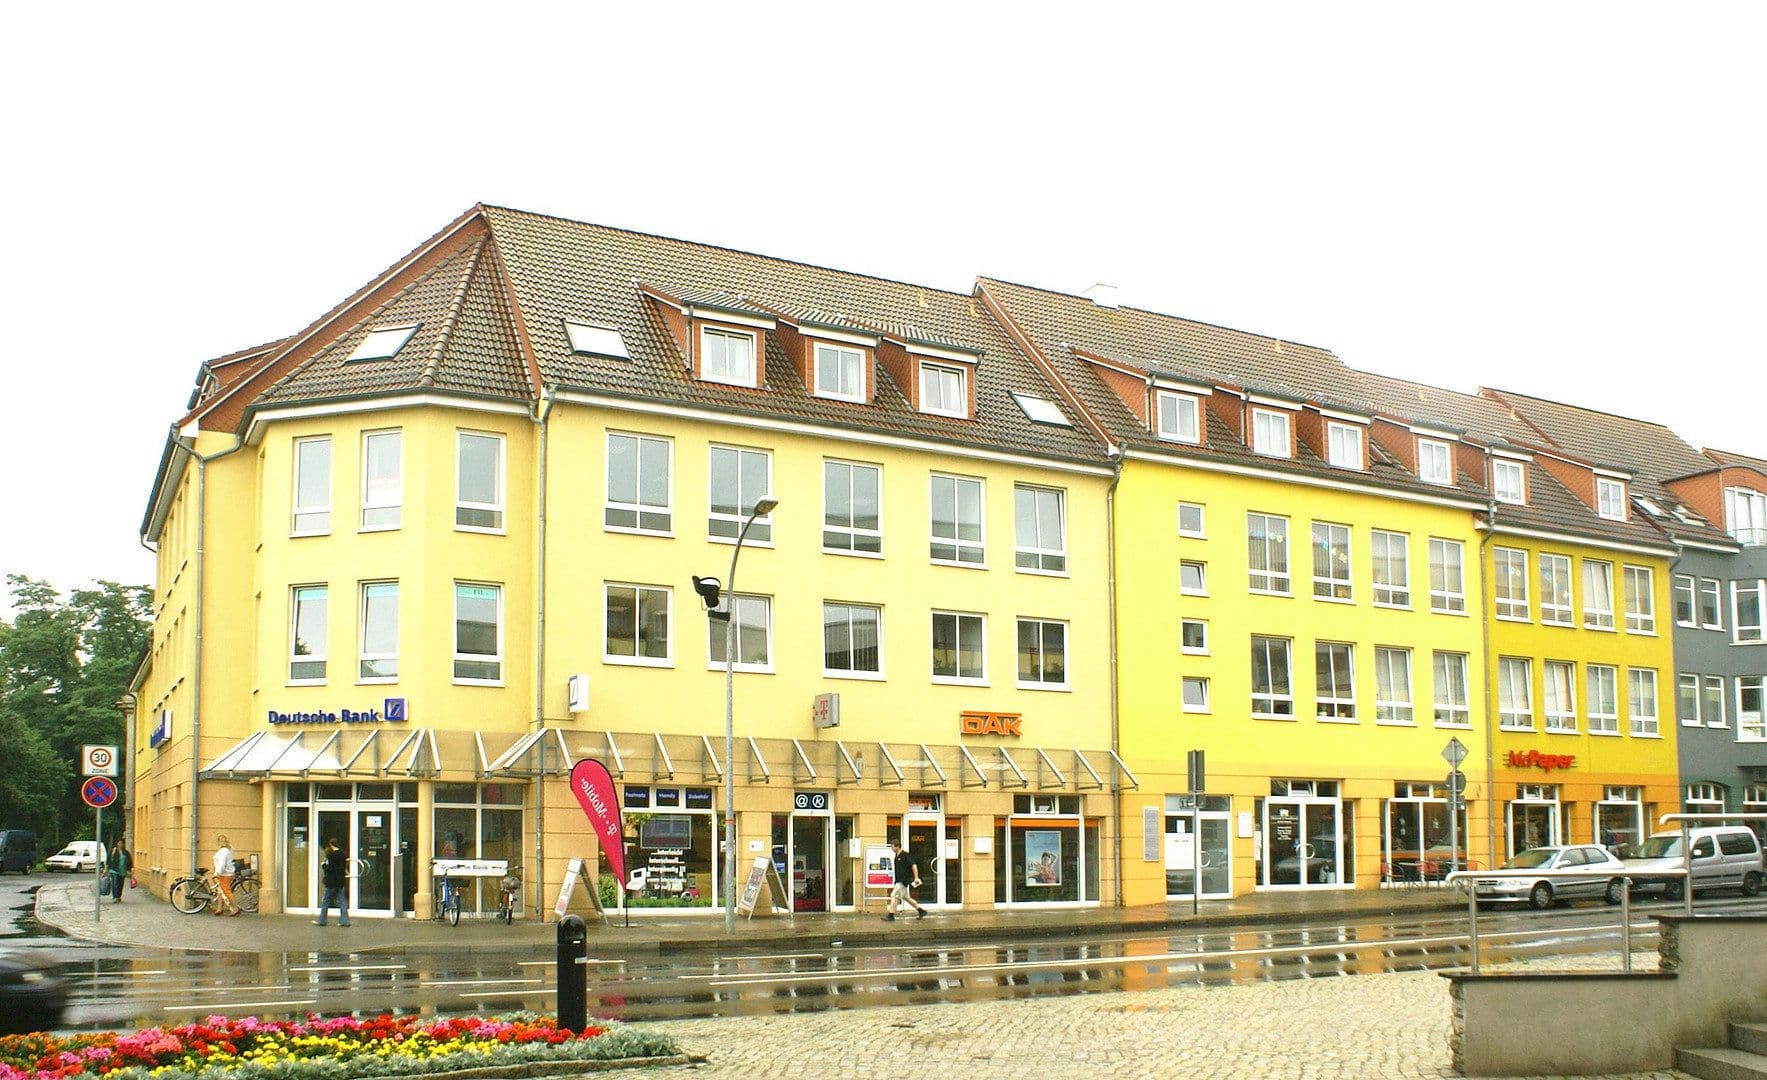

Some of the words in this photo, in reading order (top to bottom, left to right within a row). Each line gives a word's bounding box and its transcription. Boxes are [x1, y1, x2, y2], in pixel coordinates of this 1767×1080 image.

[268, 709, 336, 724] Deutsche
[341, 708, 380, 723] Bank
[960, 710, 1023, 737] DAK
[94, 752, 107, 763] 30
[795, 794, 809, 808] @
